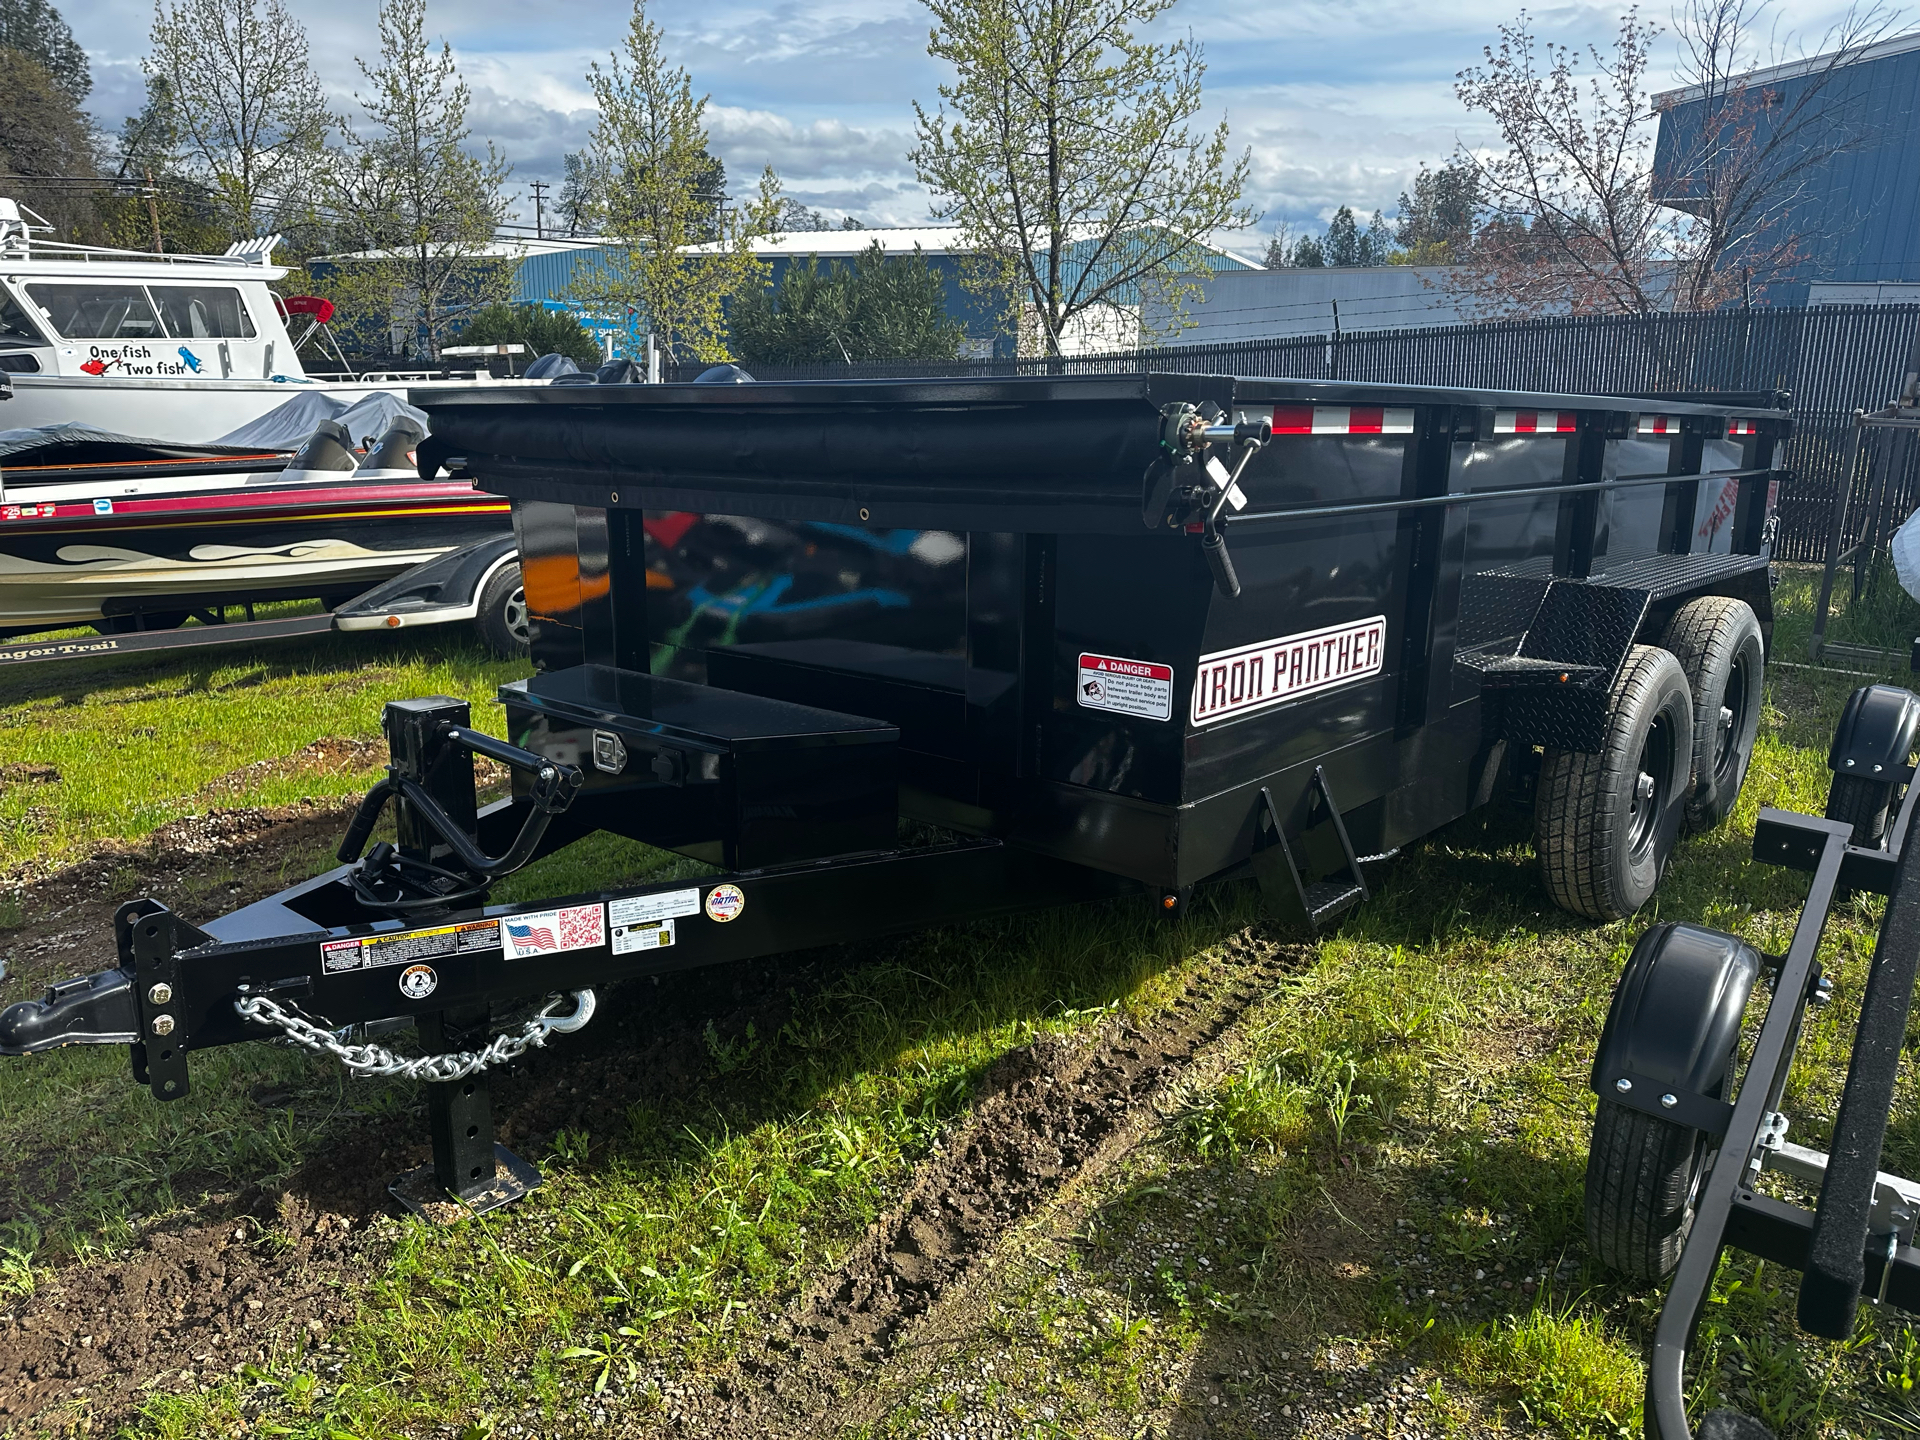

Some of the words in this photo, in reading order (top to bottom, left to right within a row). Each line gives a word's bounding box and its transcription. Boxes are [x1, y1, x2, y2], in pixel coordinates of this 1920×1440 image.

[90, 345, 118, 358] One
[122, 345, 151, 358] fish
[123, 363, 153, 375] Two
[157, 361, 184, 375] fish
[8, 508, 20, 516] 25
[58, 641, 119, 654] Trail
[1110, 662, 1152, 676] DANGER
[1198, 655, 1264, 714] IRON
[1272, 628, 1380, 693] PANTHER
[1121, 695, 1138, 703] without
[1144, 691, 1156, 699] body
[1129, 704, 1148, 712] position.
[504, 915, 522, 923] MADE
[467, 921, 495, 931] WARNING
[383, 933, 411, 942] CAUTION
[331, 940, 359, 950] DANGER
